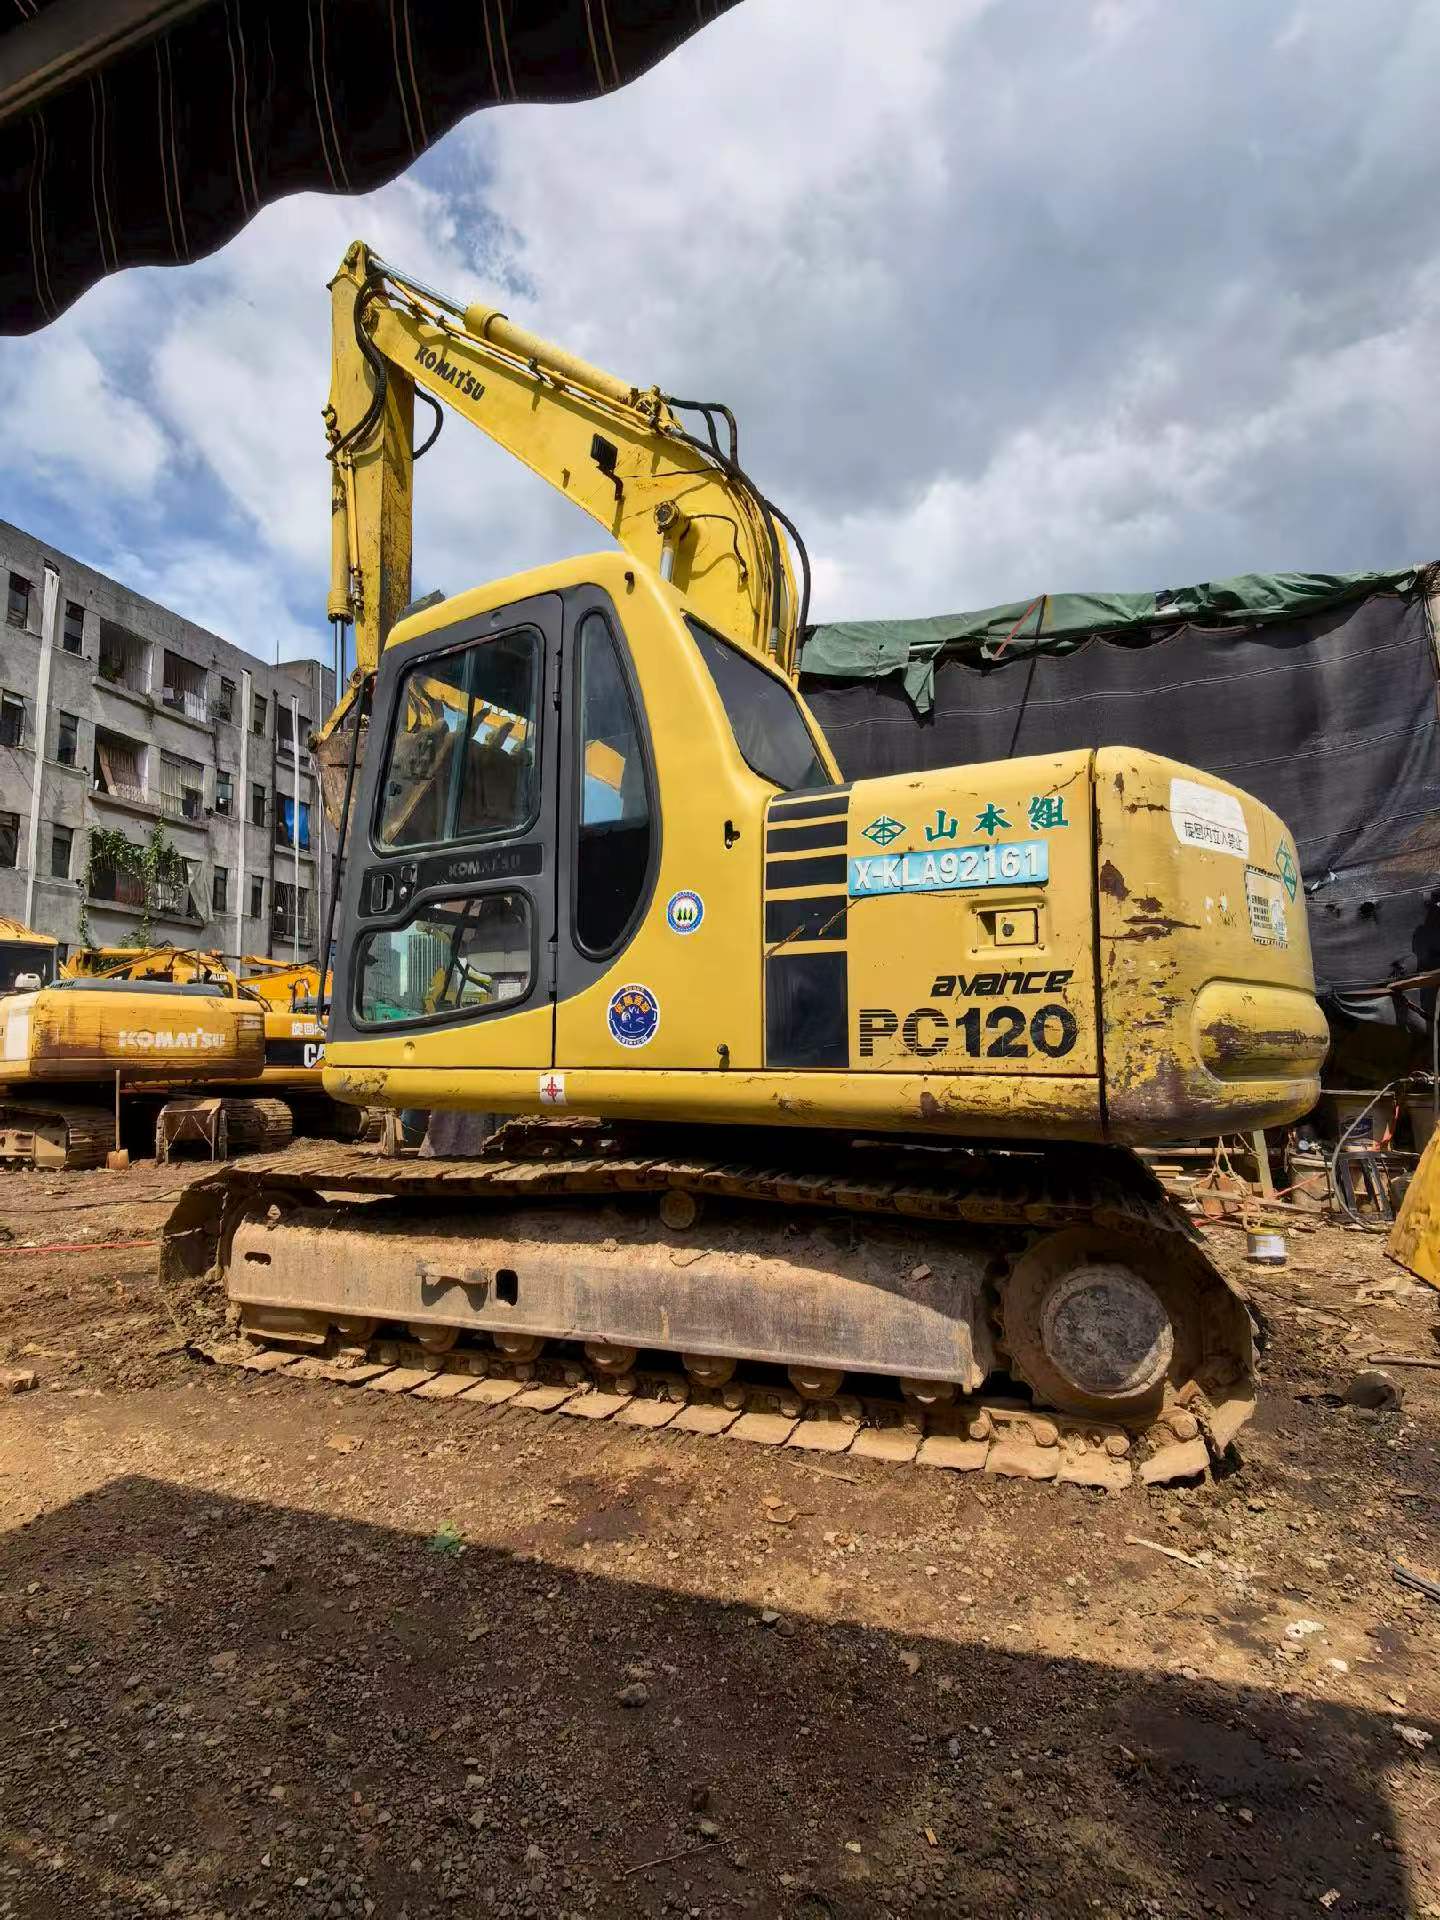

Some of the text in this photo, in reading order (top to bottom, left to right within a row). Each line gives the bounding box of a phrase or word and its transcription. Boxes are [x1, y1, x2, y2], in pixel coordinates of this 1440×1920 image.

[415, 344, 485, 401] KOMATSU
[925, 796, 1069, 842] 山本組
[854, 845, 1041, 890] X-KLA92161
[930, 970, 1073, 997] avance
[118, 1027, 226, 1049] KOMATSU
[859, 1004, 1078, 1058] PC120
